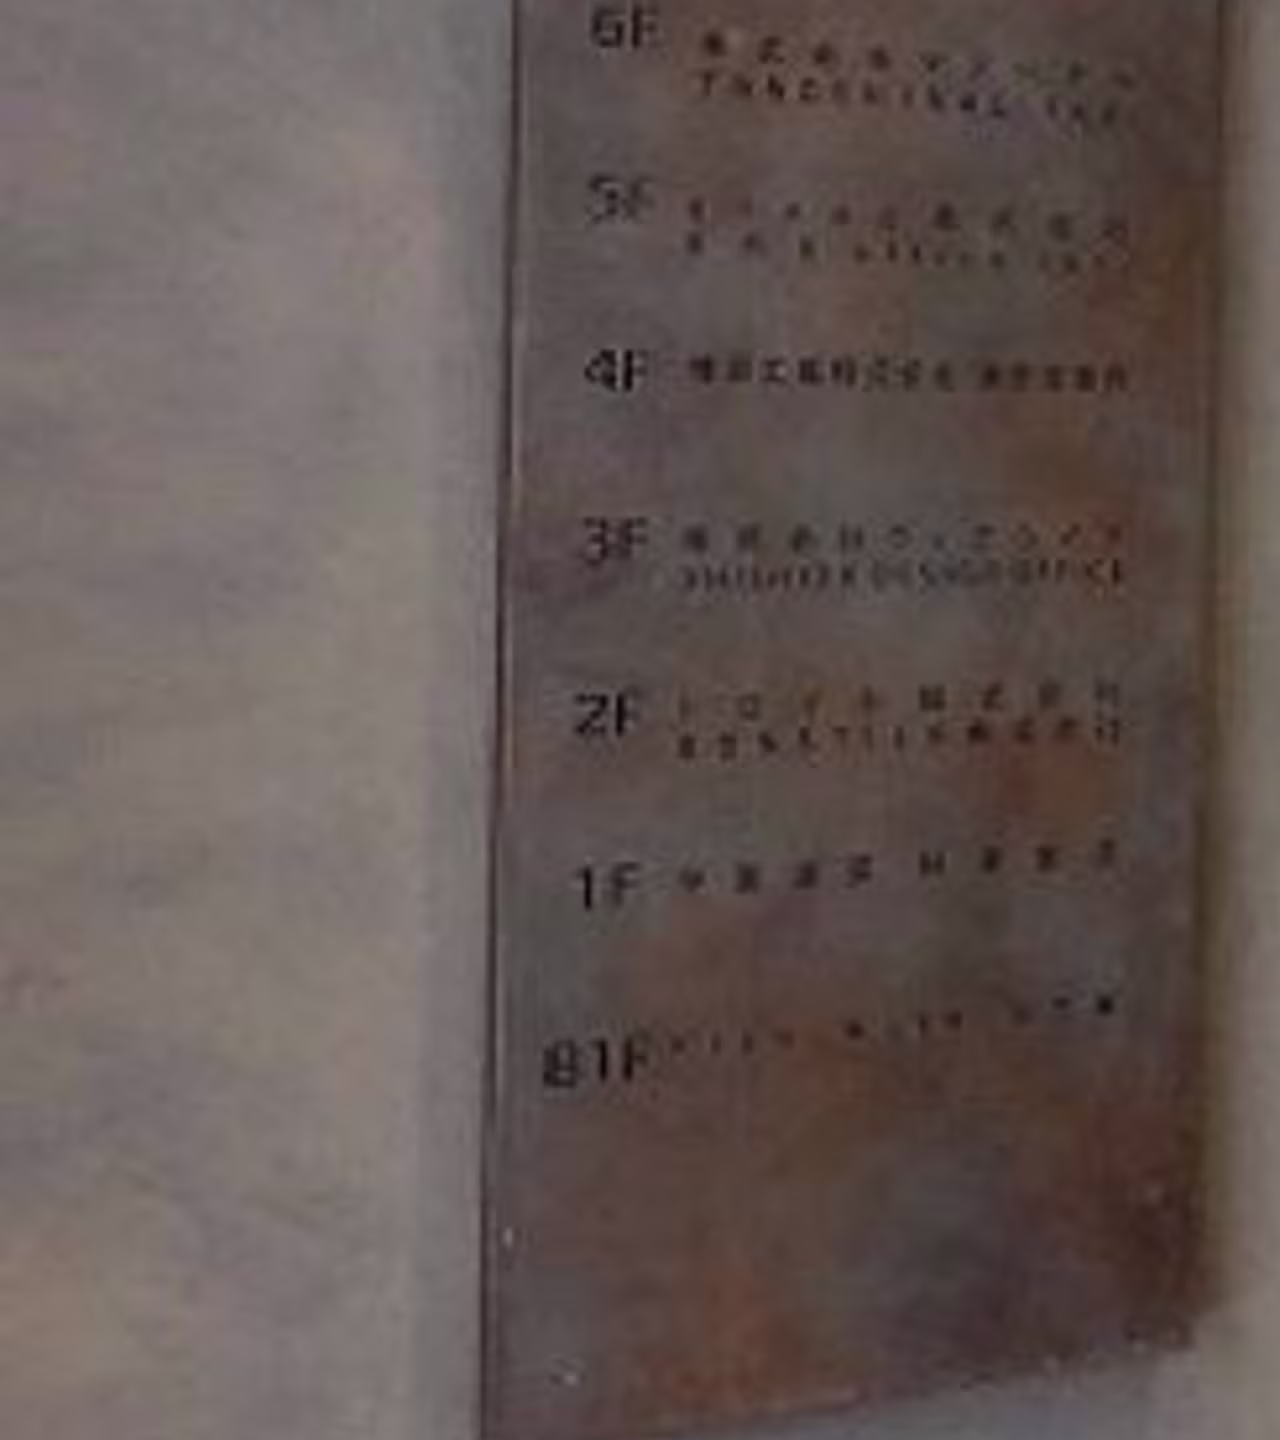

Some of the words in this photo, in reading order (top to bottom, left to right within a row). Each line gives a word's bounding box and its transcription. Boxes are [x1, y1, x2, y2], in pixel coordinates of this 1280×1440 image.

[590, 4, 660, 49] 6F
[585, 175, 655, 222] 5F
[584, 349, 648, 391] 4F
[580, 517, 650, 566] 3F
[572, 692, 640, 738] 2F
[576, 861, 642, 910] 1F
